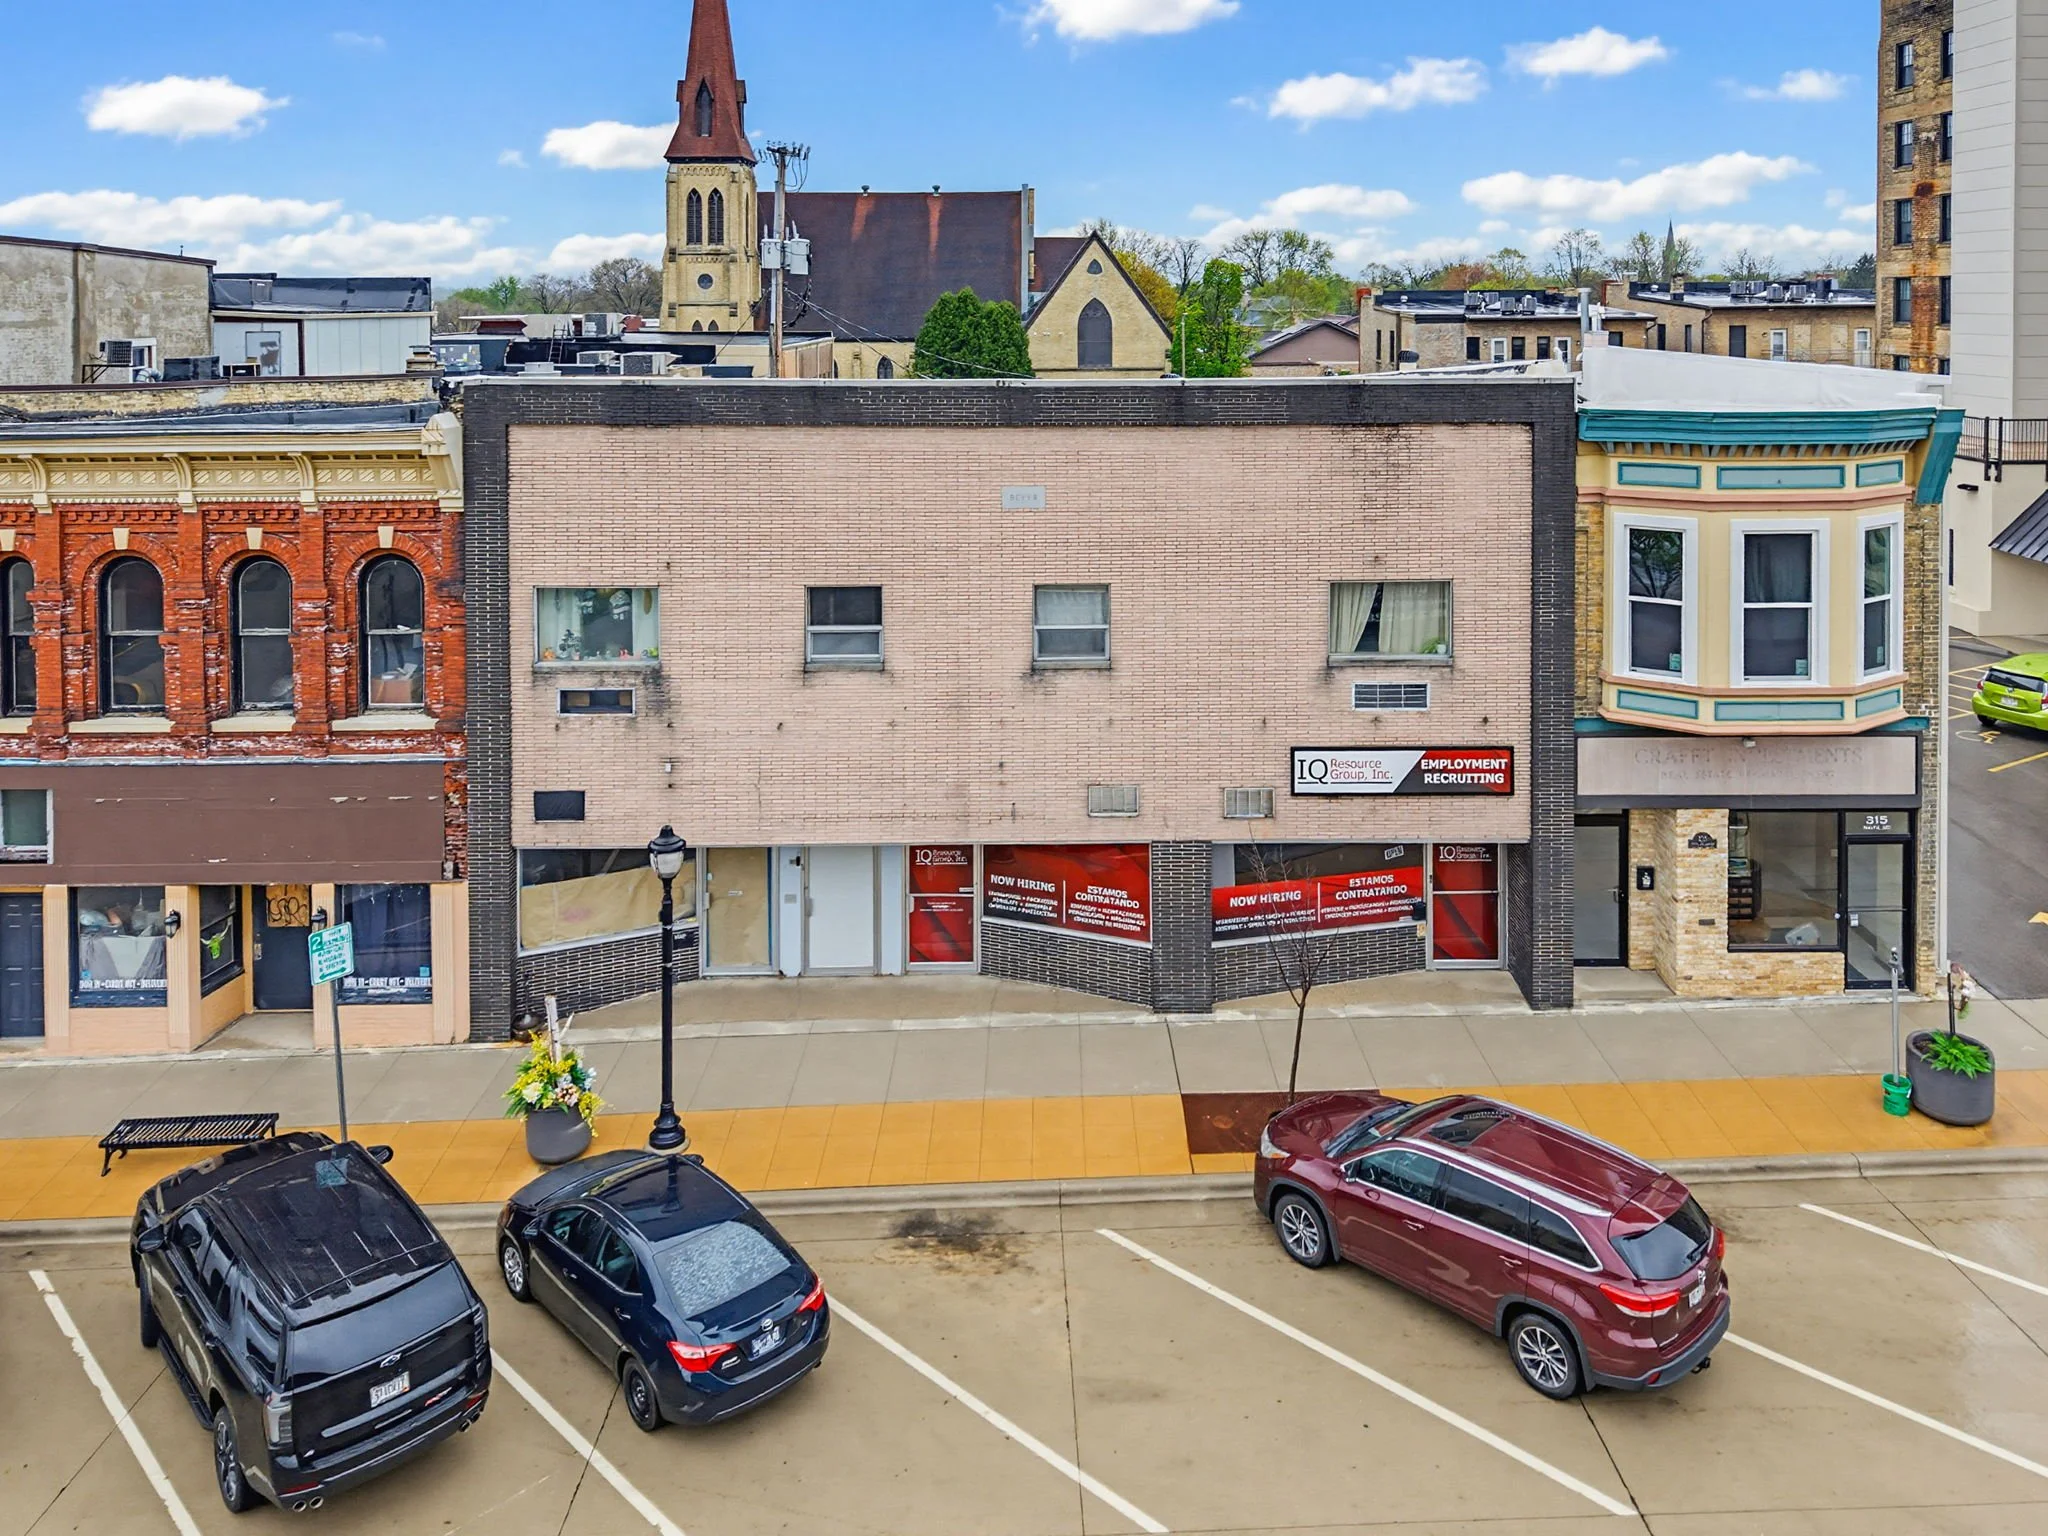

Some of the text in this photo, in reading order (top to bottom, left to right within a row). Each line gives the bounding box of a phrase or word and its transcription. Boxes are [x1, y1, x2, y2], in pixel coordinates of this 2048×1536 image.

[1330, 758, 1382, 769] Resource
[1421, 759, 1508, 770] EMPLOYMENT
[1297, 758, 1329, 785] IQ
[1330, 769, 1393, 781] Group, Inc.
[1424, 773, 1505, 784] RECRUITING
[1865, 815, 1889, 825] 315
[915, 849, 933, 866] IQ
[1439, 846, 1456, 862] IQ
[991, 874, 1056, 893] NOW HIRING
[1349, 874, 1394, 888] ESTAMOS
[1087, 885, 1128, 899] ESTAMOS
[1229, 890, 1302, 908] NOW HIRING
[1335, 885, 1408, 900] CONTRATANDO
[1075, 892, 1140, 909] CONTRATANDO
[311, 936, 321, 950] 2
